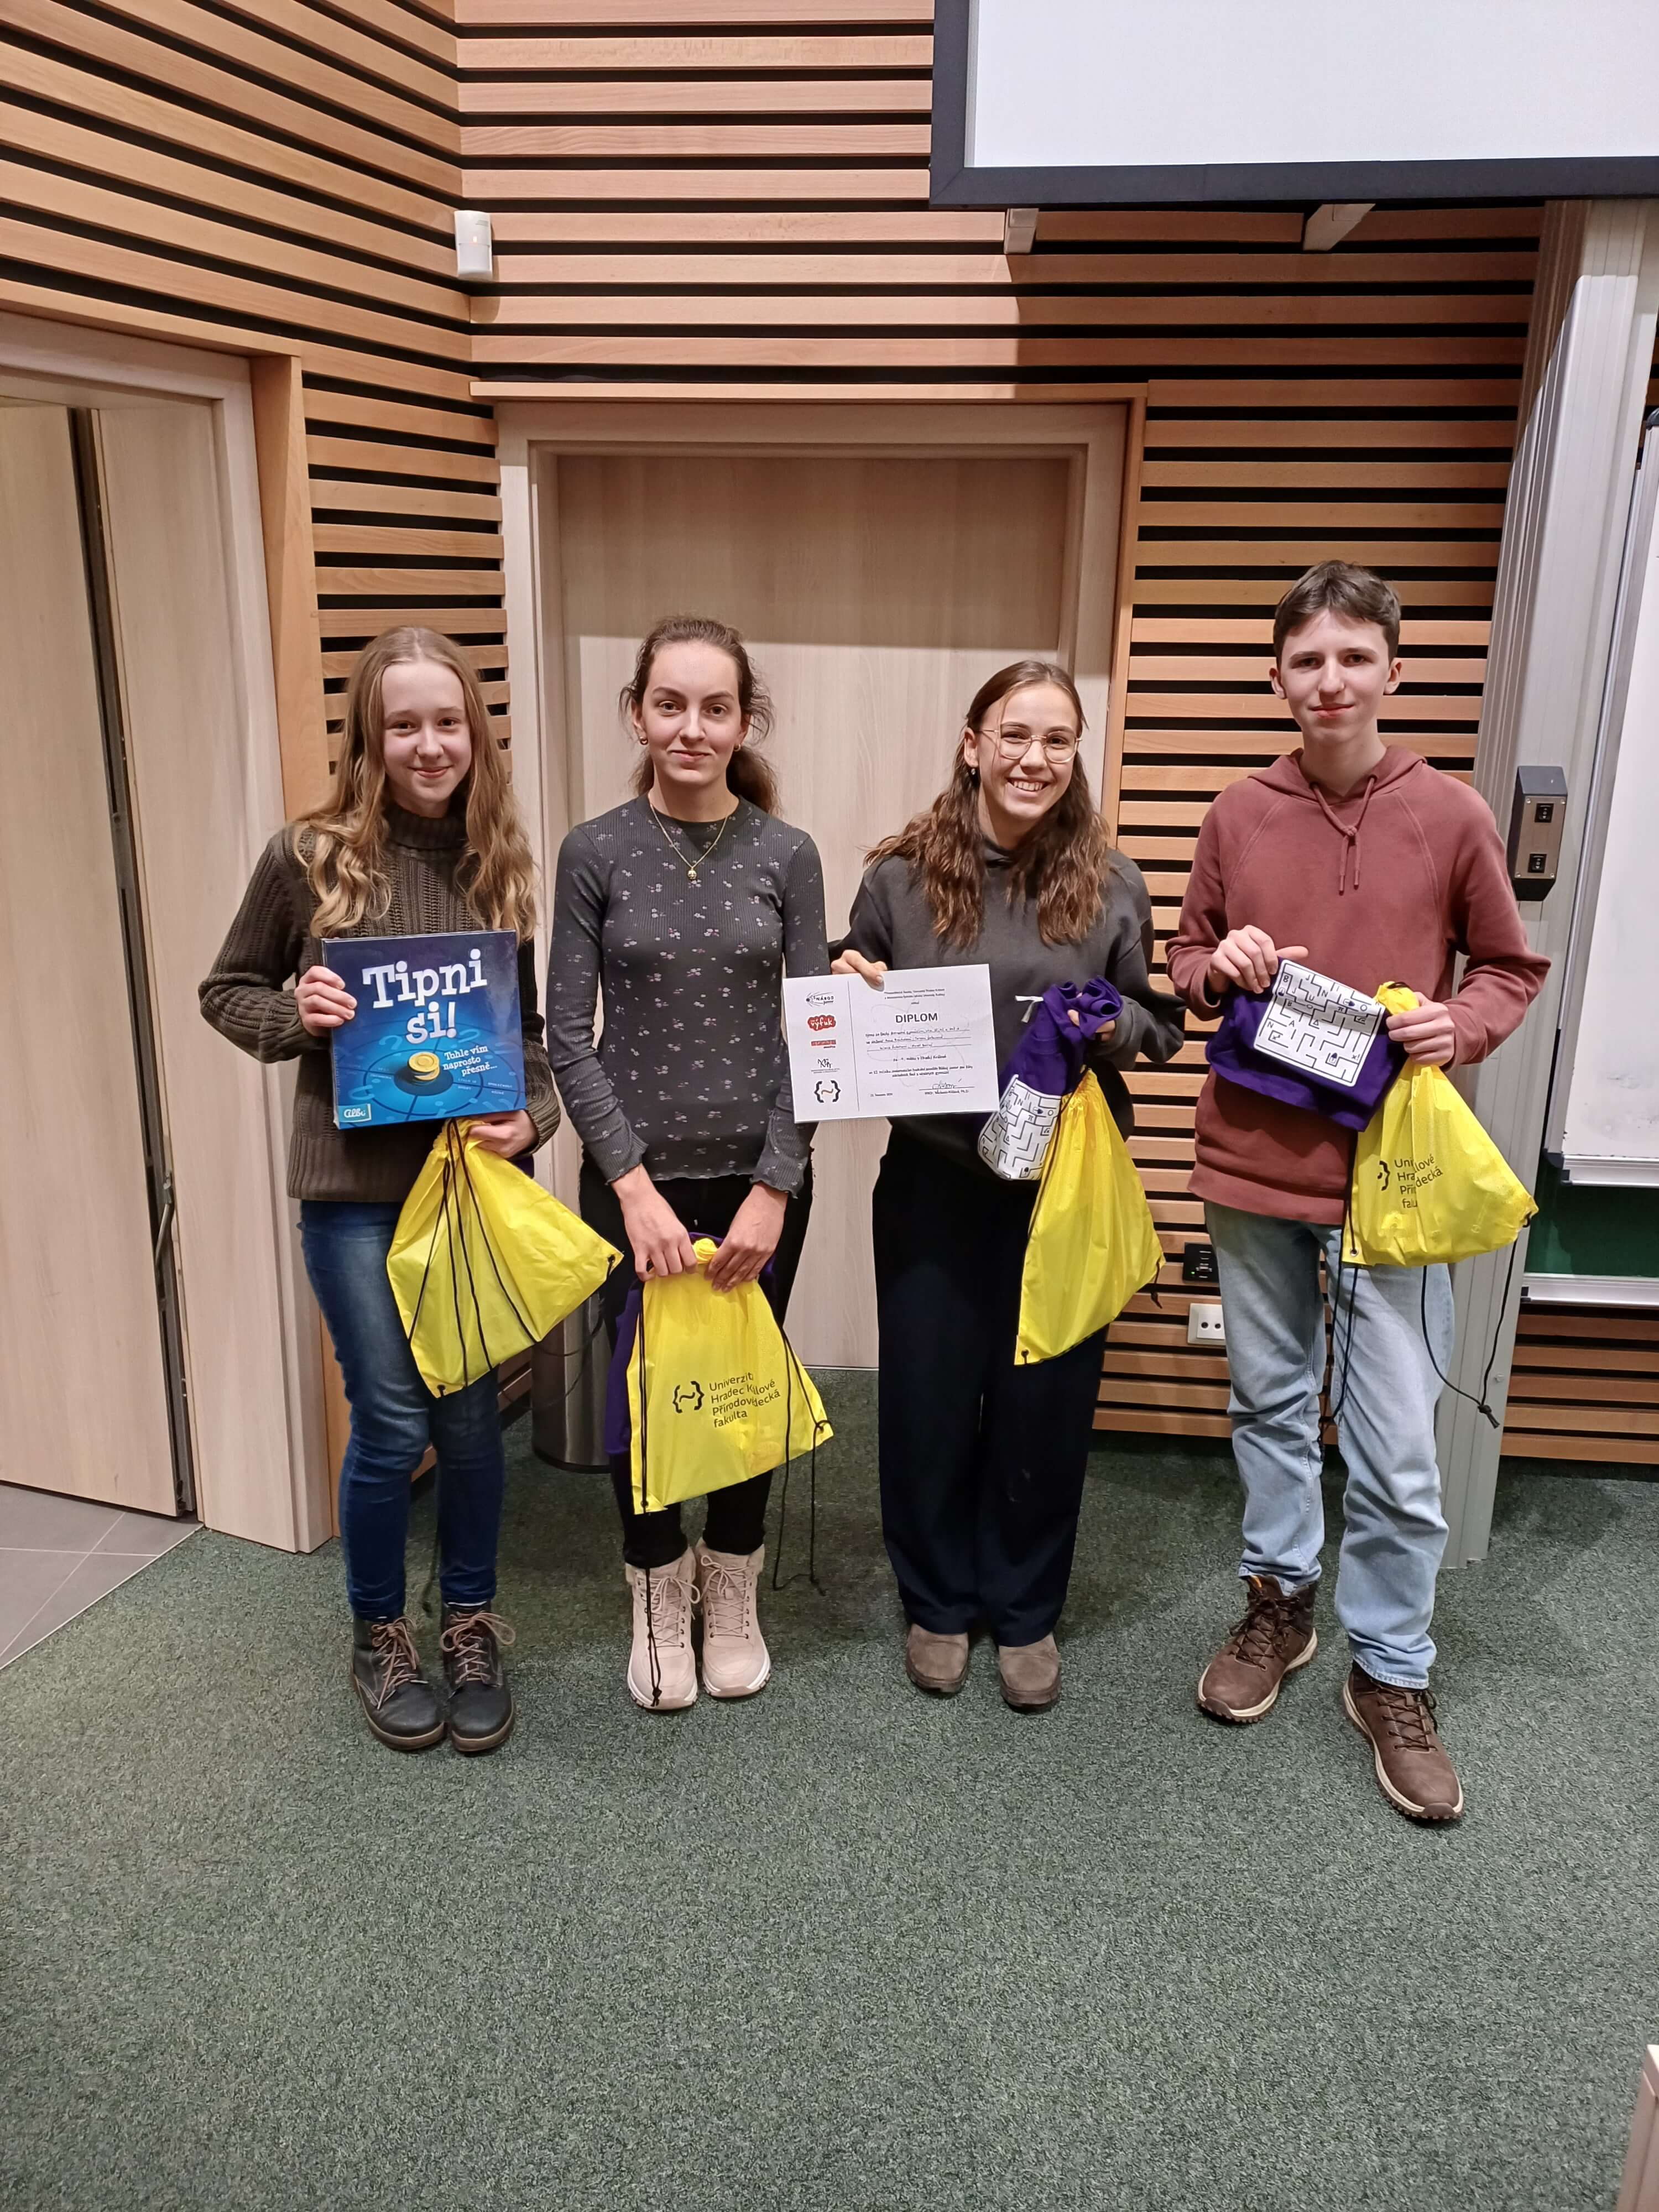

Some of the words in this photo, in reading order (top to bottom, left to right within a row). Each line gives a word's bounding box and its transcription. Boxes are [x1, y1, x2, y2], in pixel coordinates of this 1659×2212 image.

[362, 948, 487, 1008] Tipni
[405, 1001, 457, 1044] si!
[810, 1018, 832, 1029] výfuk
[895, 1013, 938, 1023] DIPLOM
[444, 1048, 469, 1060] Tohle
[469, 1045, 488, 1055] vím
[442, 1056, 481, 1070] naprosto
[709, 1372, 754, 1391] Univerzit
[711, 1387, 744, 1404] Hradec
[747, 1379, 775, 1395] Klové
[713, 1411, 748, 1428] fakulta
